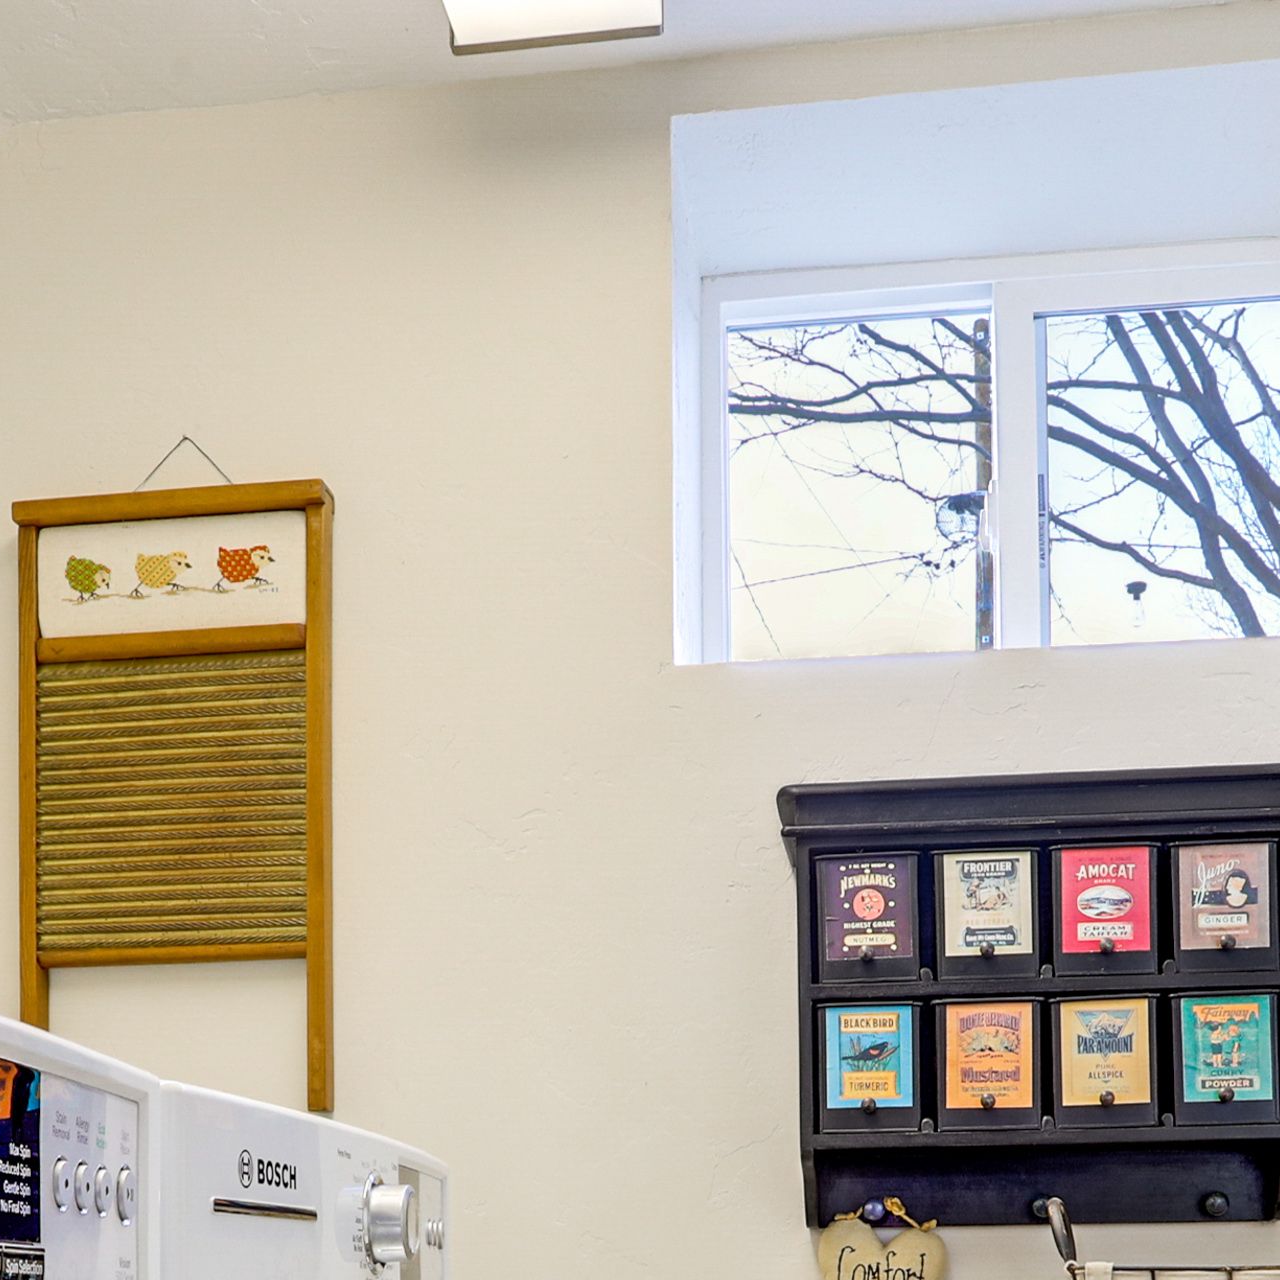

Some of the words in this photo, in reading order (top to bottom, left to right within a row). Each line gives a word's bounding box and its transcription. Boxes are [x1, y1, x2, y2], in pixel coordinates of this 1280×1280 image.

[963, 861, 1012, 873] FRONTIER
[1075, 863, 1136, 881] AMOCAT
[840, 873, 896, 898] NEWMARK'S
[1193, 859, 1240, 907] Juno
[1204, 916, 1243, 924] GINGER
[1201, 1007, 1249, 1021] Fairway
[960, 1066, 1020, 1084] Mustard
[1088, 1070, 1124, 1080] ALLSPICE
[849, 1081, 889, 1092] TURMERIC
[1205, 1080, 1251, 1088] POWDER
[257, 1158, 297, 1190] BOSCH
[6, 1259, 19, 1278] Spin
[19, 1258, 43, 1275] Selection
